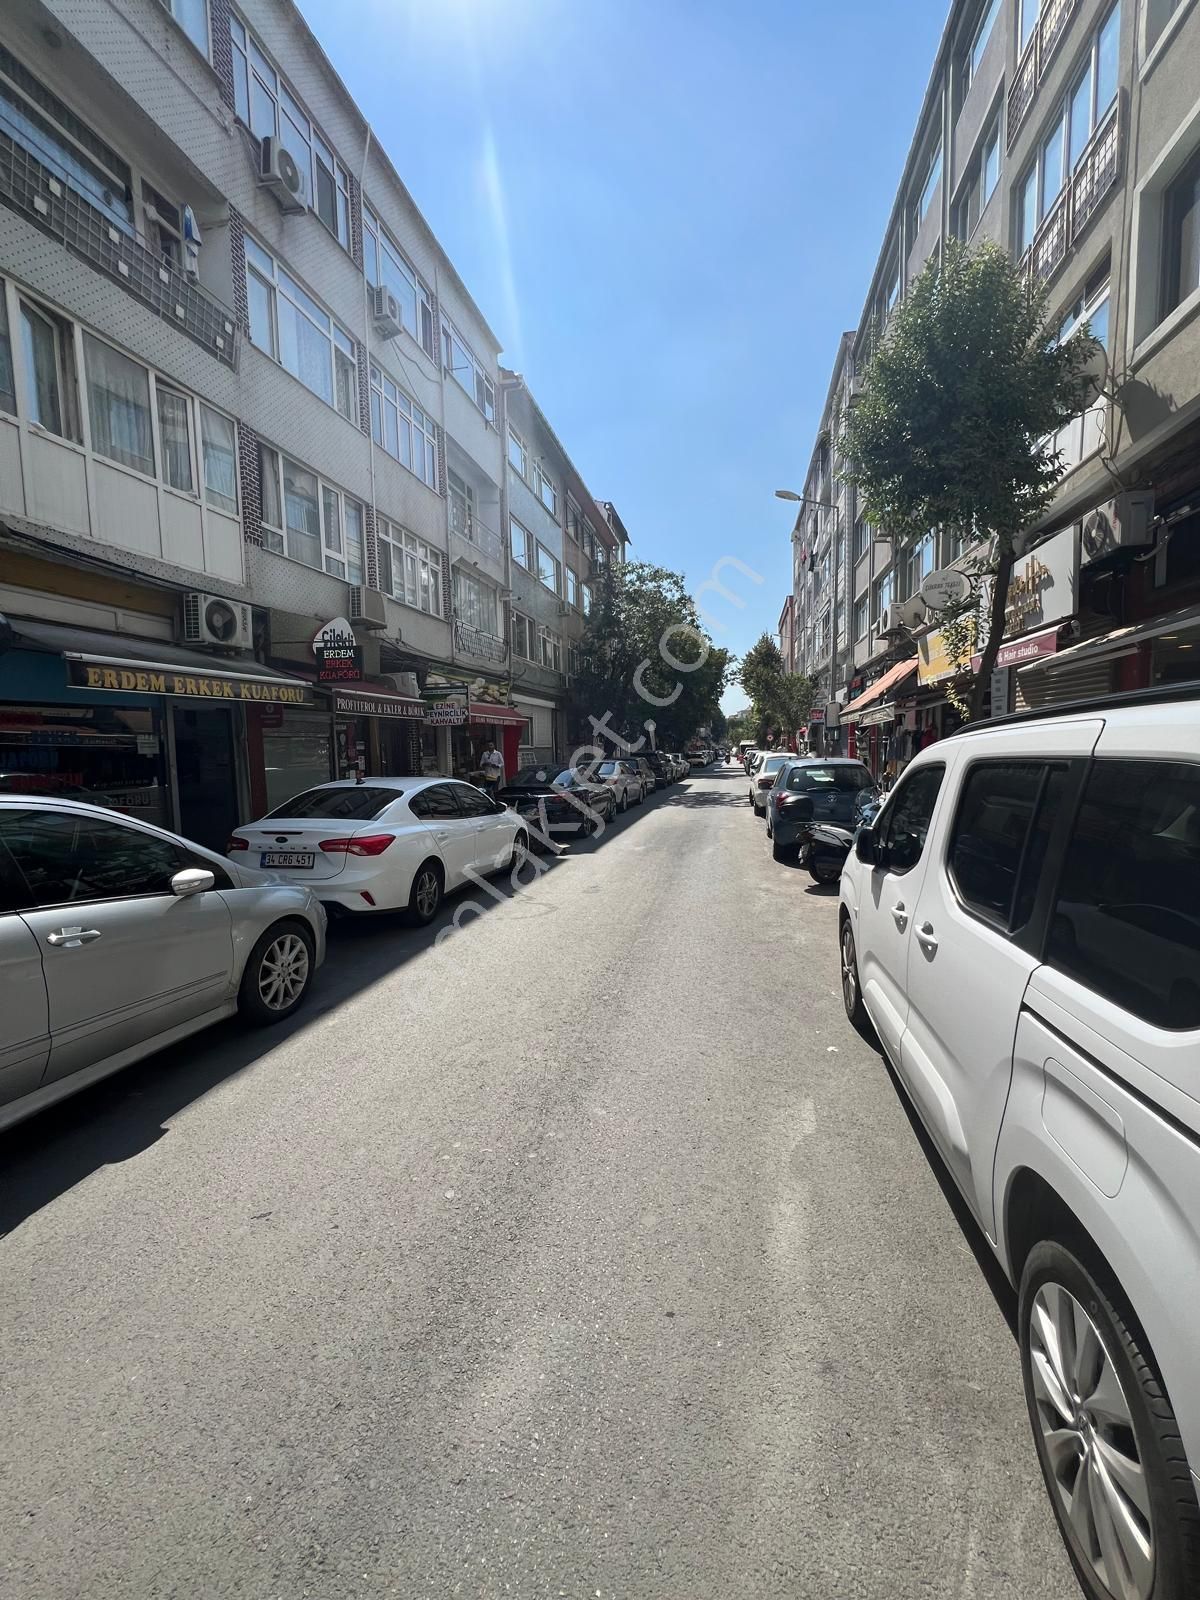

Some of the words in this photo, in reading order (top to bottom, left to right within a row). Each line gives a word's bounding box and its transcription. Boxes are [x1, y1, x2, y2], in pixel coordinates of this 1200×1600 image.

[323, 649, 355, 659] ERDEM
[1004, 651, 1016, 662] Hair
[1017, 643, 1038, 657] studio
[325, 659, 353, 668] ERKEK
[86, 667, 165, 692] ERDEM
[174, 676, 236, 698] ERKEK
[430, 717, 462, 725] KAHVALTI
[266, 854, 275, 865] 34
[278, 854, 293, 865] CRG
[296, 855, 311, 865] 451
